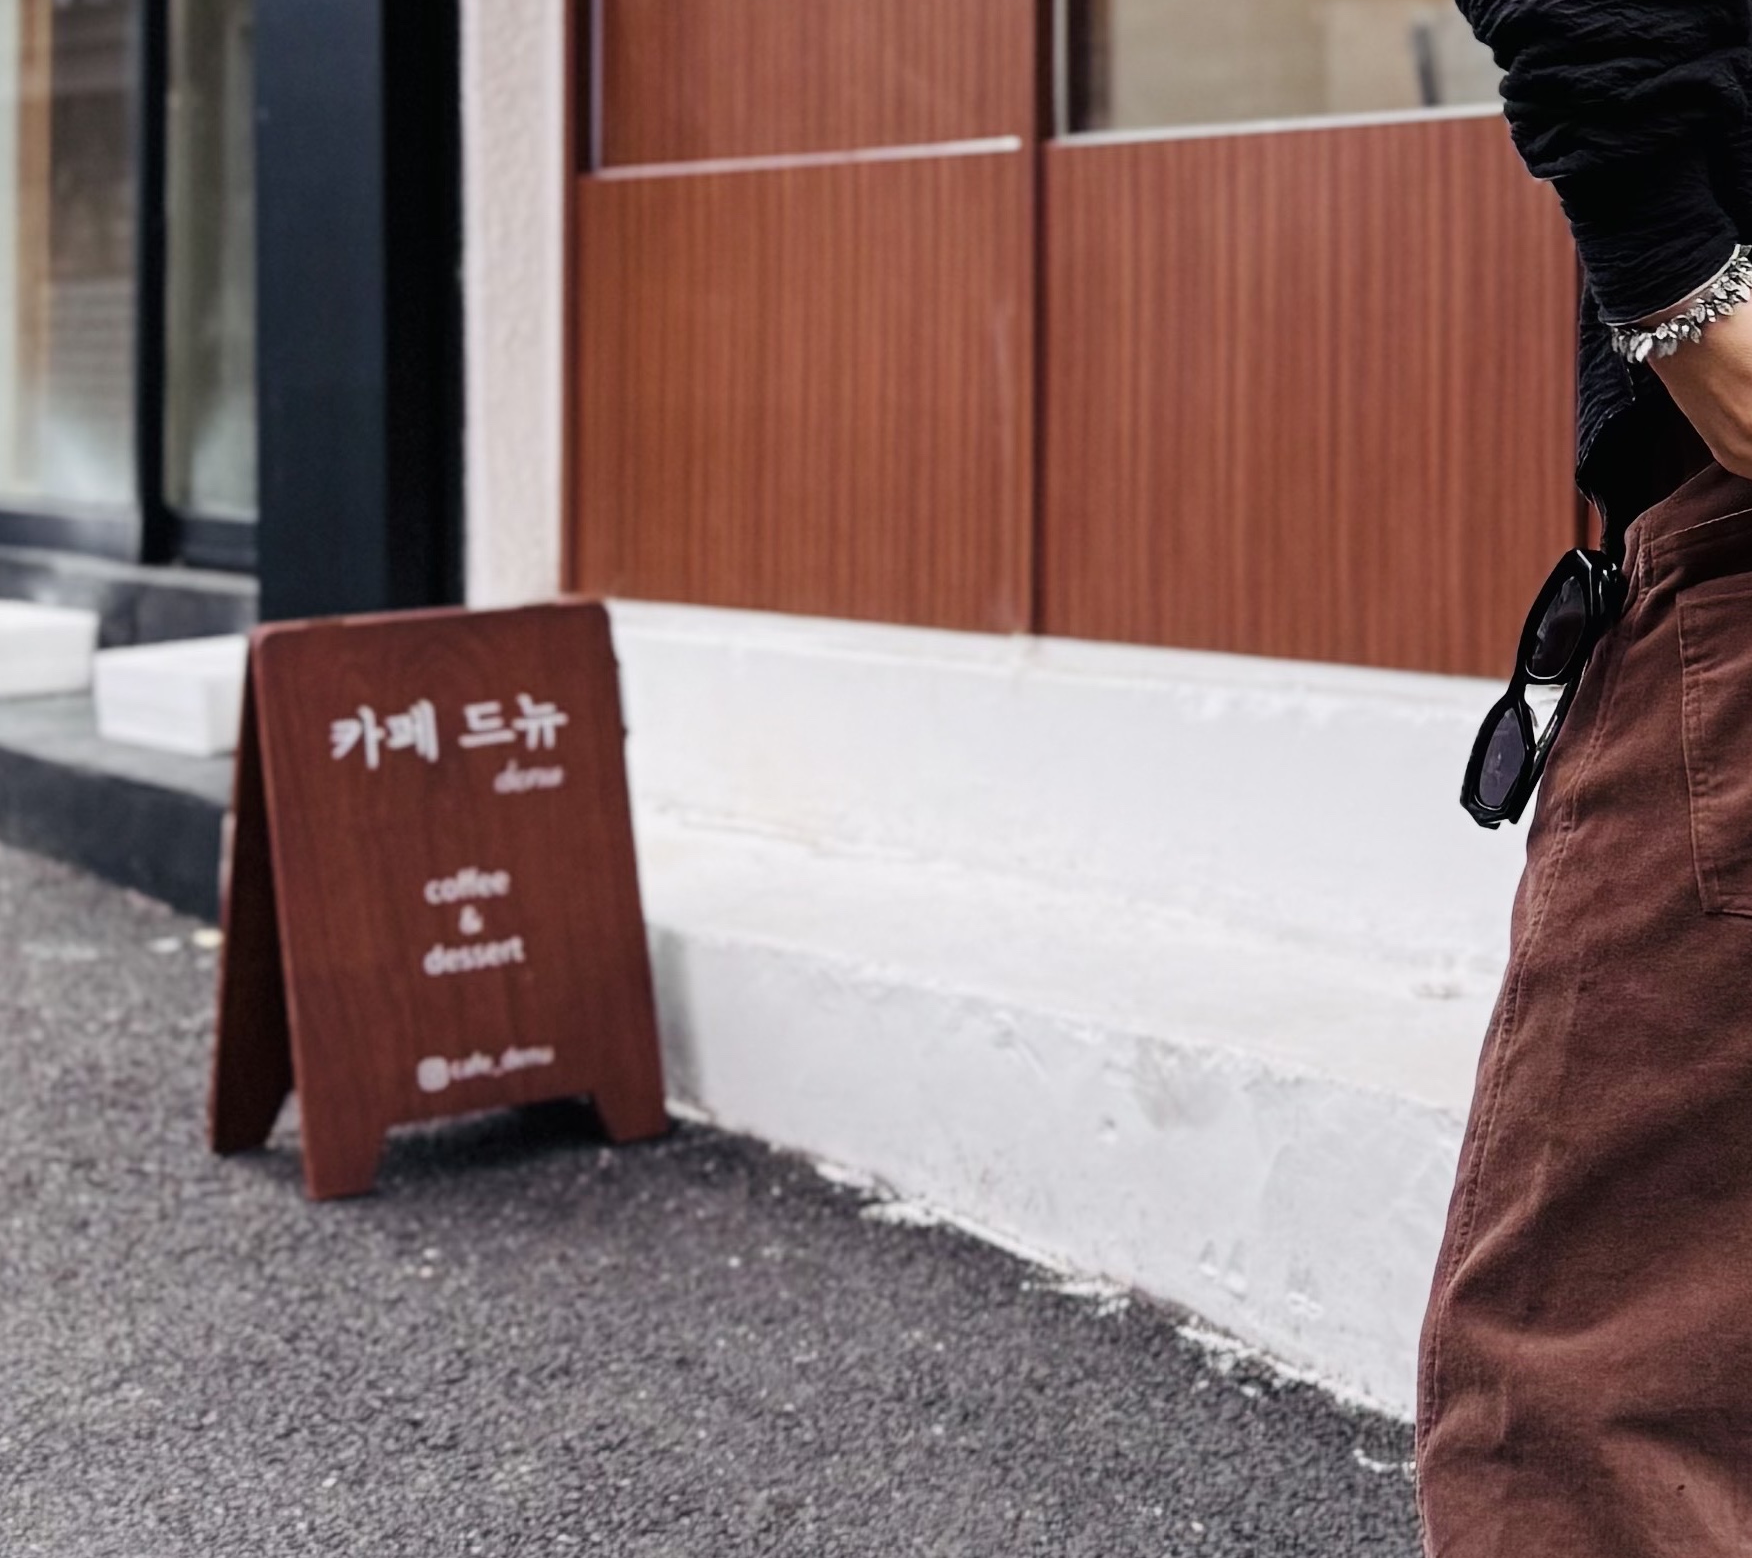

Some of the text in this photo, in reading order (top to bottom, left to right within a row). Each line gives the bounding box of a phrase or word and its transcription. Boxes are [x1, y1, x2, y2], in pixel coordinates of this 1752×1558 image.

[331, 694, 568, 769] 카페 드뉴
[424, 868, 510, 904] coffee
[459, 906, 484, 935] &
[423, 937, 525, 976] dessert
